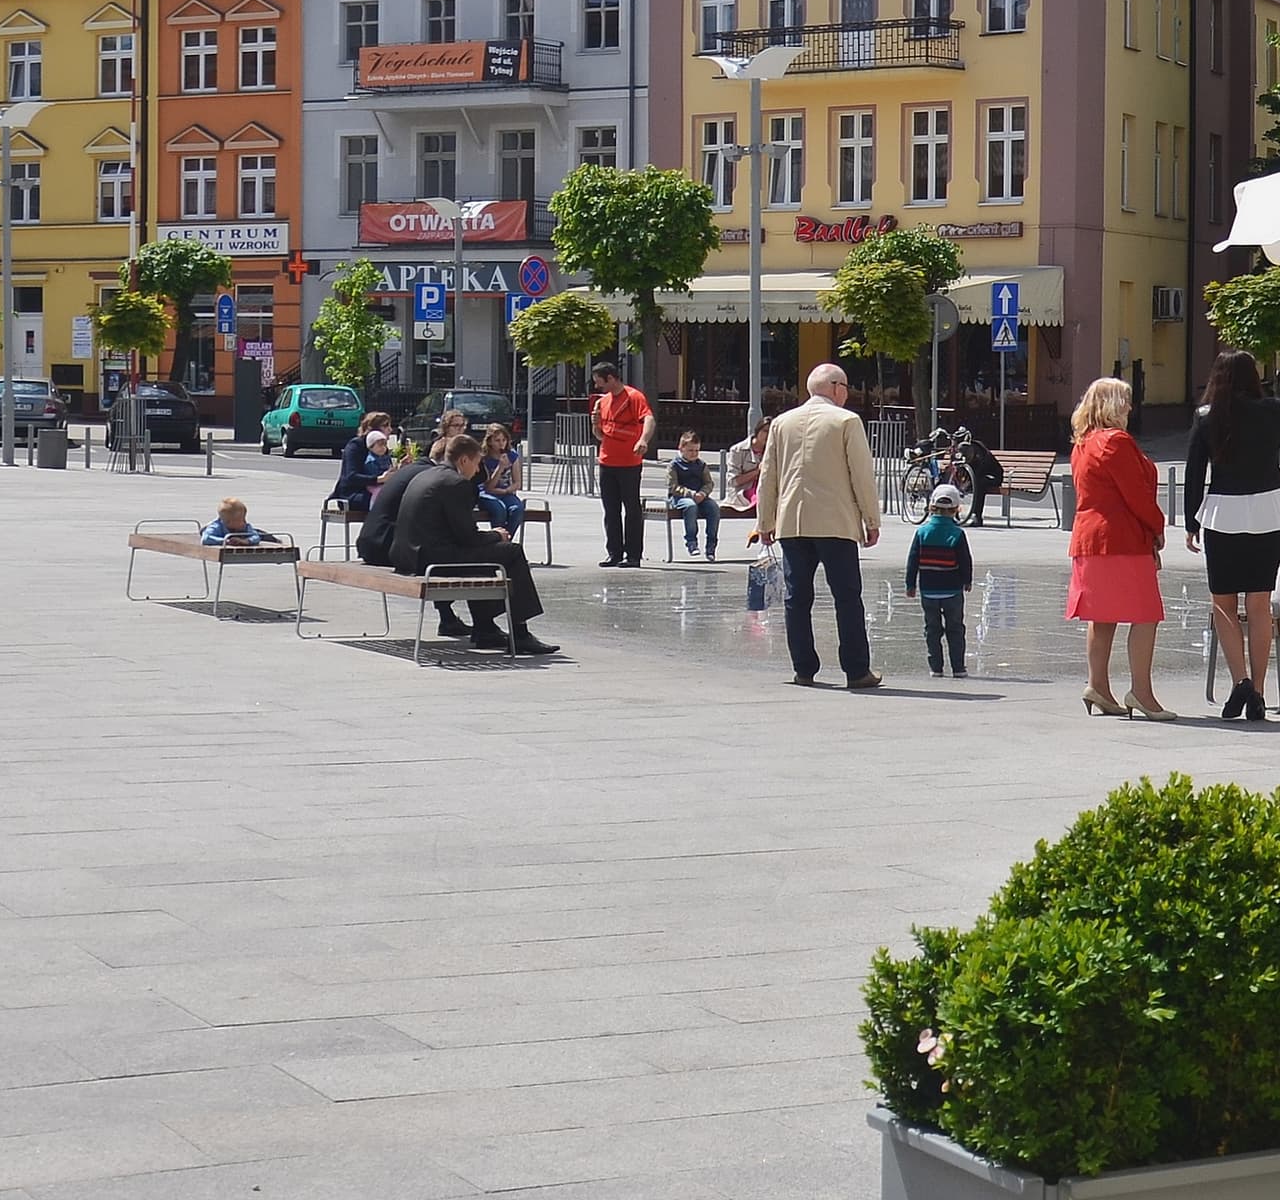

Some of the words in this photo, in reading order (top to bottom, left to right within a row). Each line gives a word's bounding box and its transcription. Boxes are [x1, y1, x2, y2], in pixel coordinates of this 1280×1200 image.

[491, 56, 502, 65] od
[167, 228, 277, 240] CENTRUM
[228, 241, 280, 250] WZROKU
[375, 265, 509, 292] APTEKA
[421, 287, 439, 310] P
